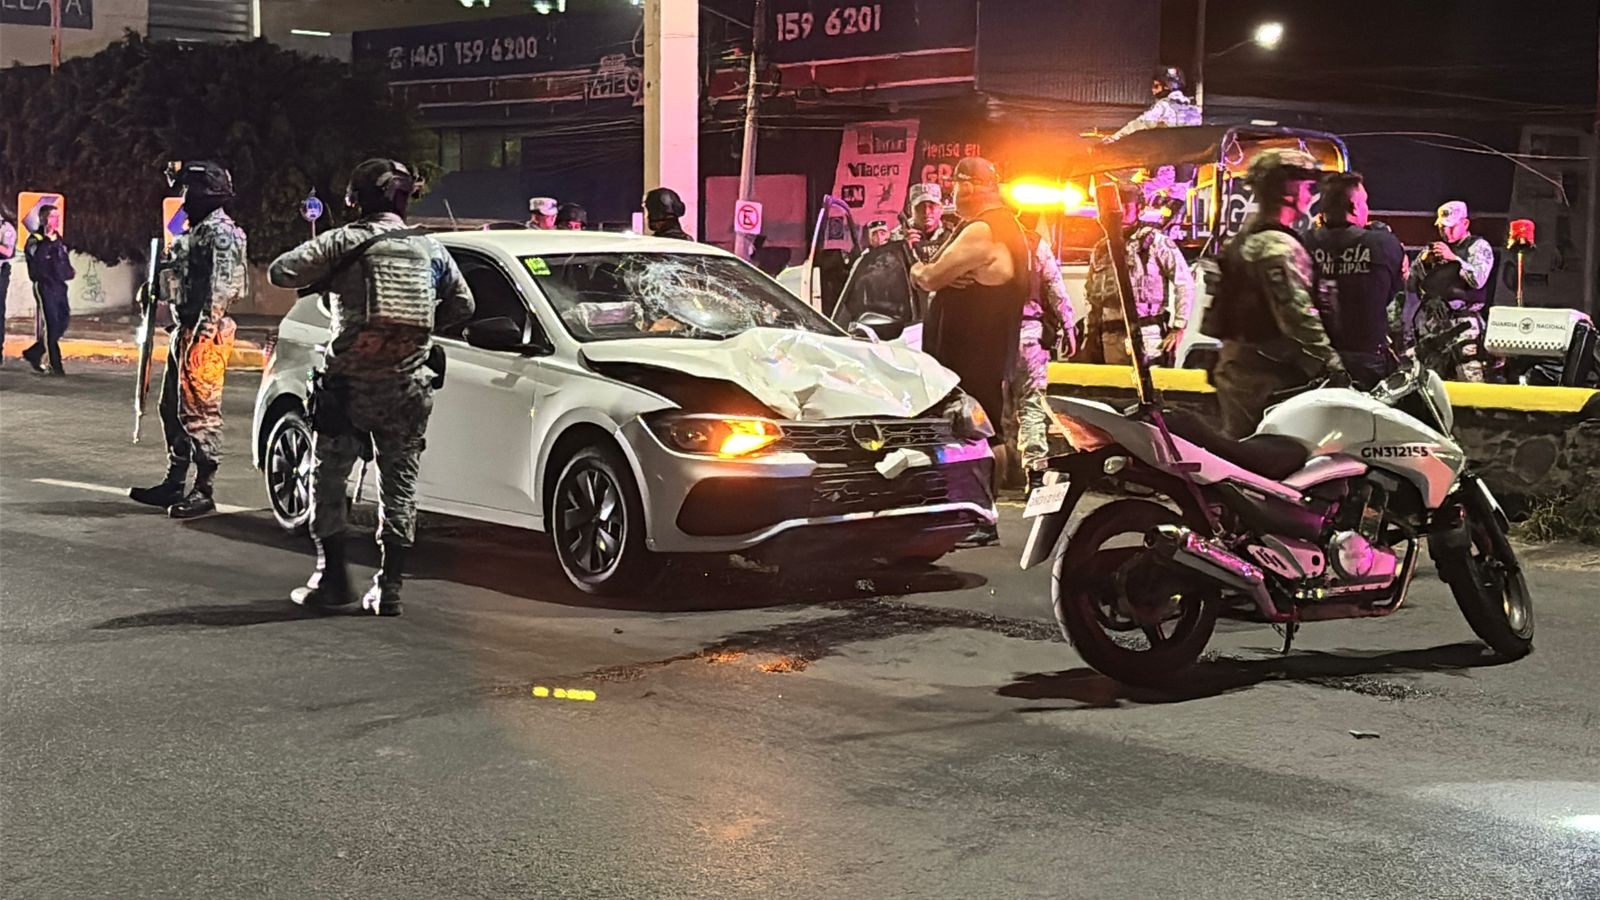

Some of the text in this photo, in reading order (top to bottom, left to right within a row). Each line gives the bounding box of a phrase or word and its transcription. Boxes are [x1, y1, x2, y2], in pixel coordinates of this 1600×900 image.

[776, 4, 881, 41] 159 6201
[454, 39, 484, 65] 159
[491, 36, 538, 62] 6200
[743, 209, 754, 226] E
[1491, 320, 1567, 331] GUARDIA NACIONAL
[1361, 446, 1429, 459] GN312155
